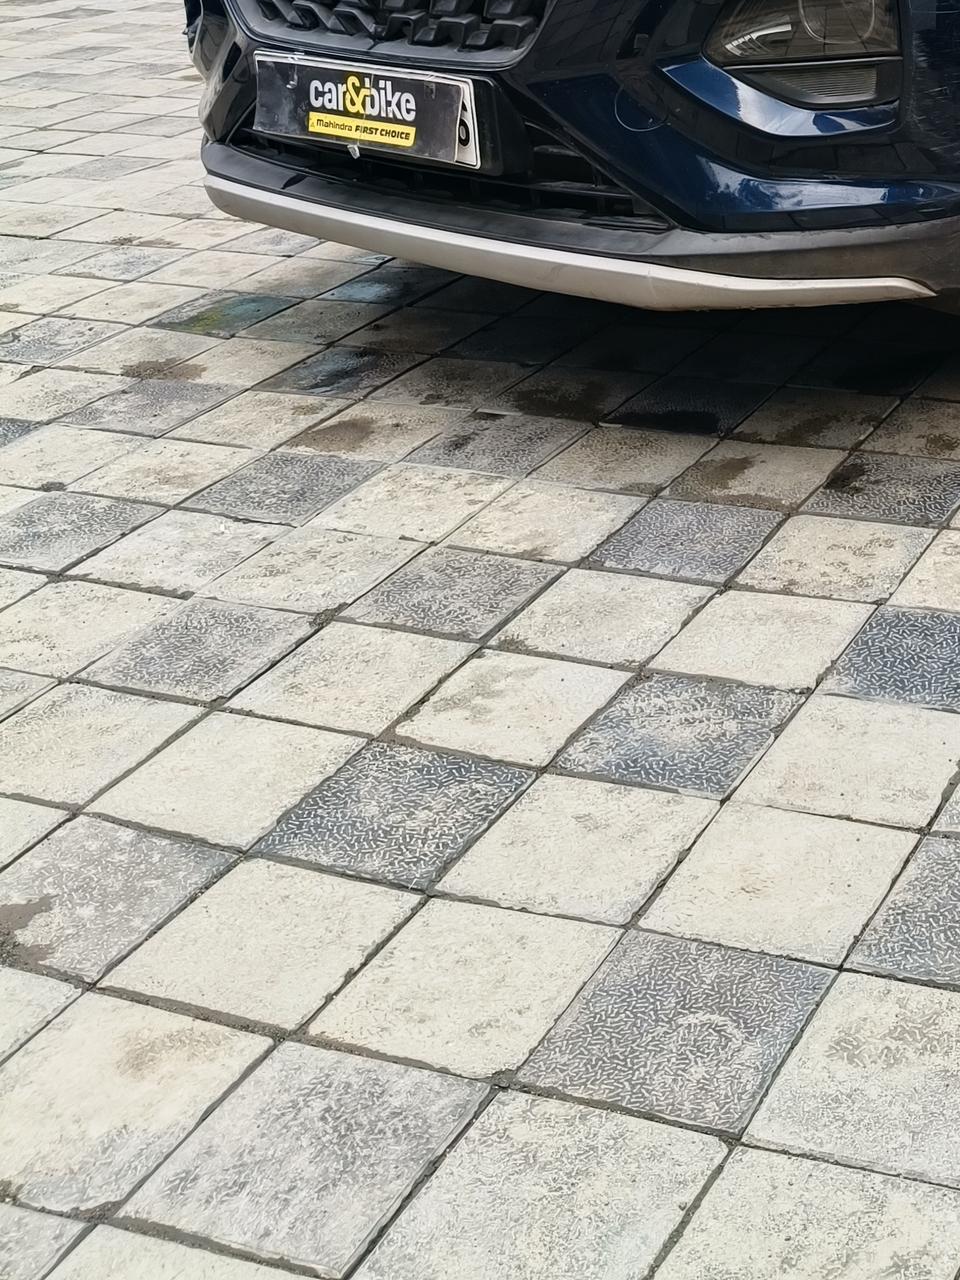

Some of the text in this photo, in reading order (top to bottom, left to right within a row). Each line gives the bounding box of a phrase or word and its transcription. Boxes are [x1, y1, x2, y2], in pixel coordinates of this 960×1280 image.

[309, 75, 416, 122] car&bike
[354, 125, 380, 136] FIRST
[380, 128, 411, 141] CHOICE
